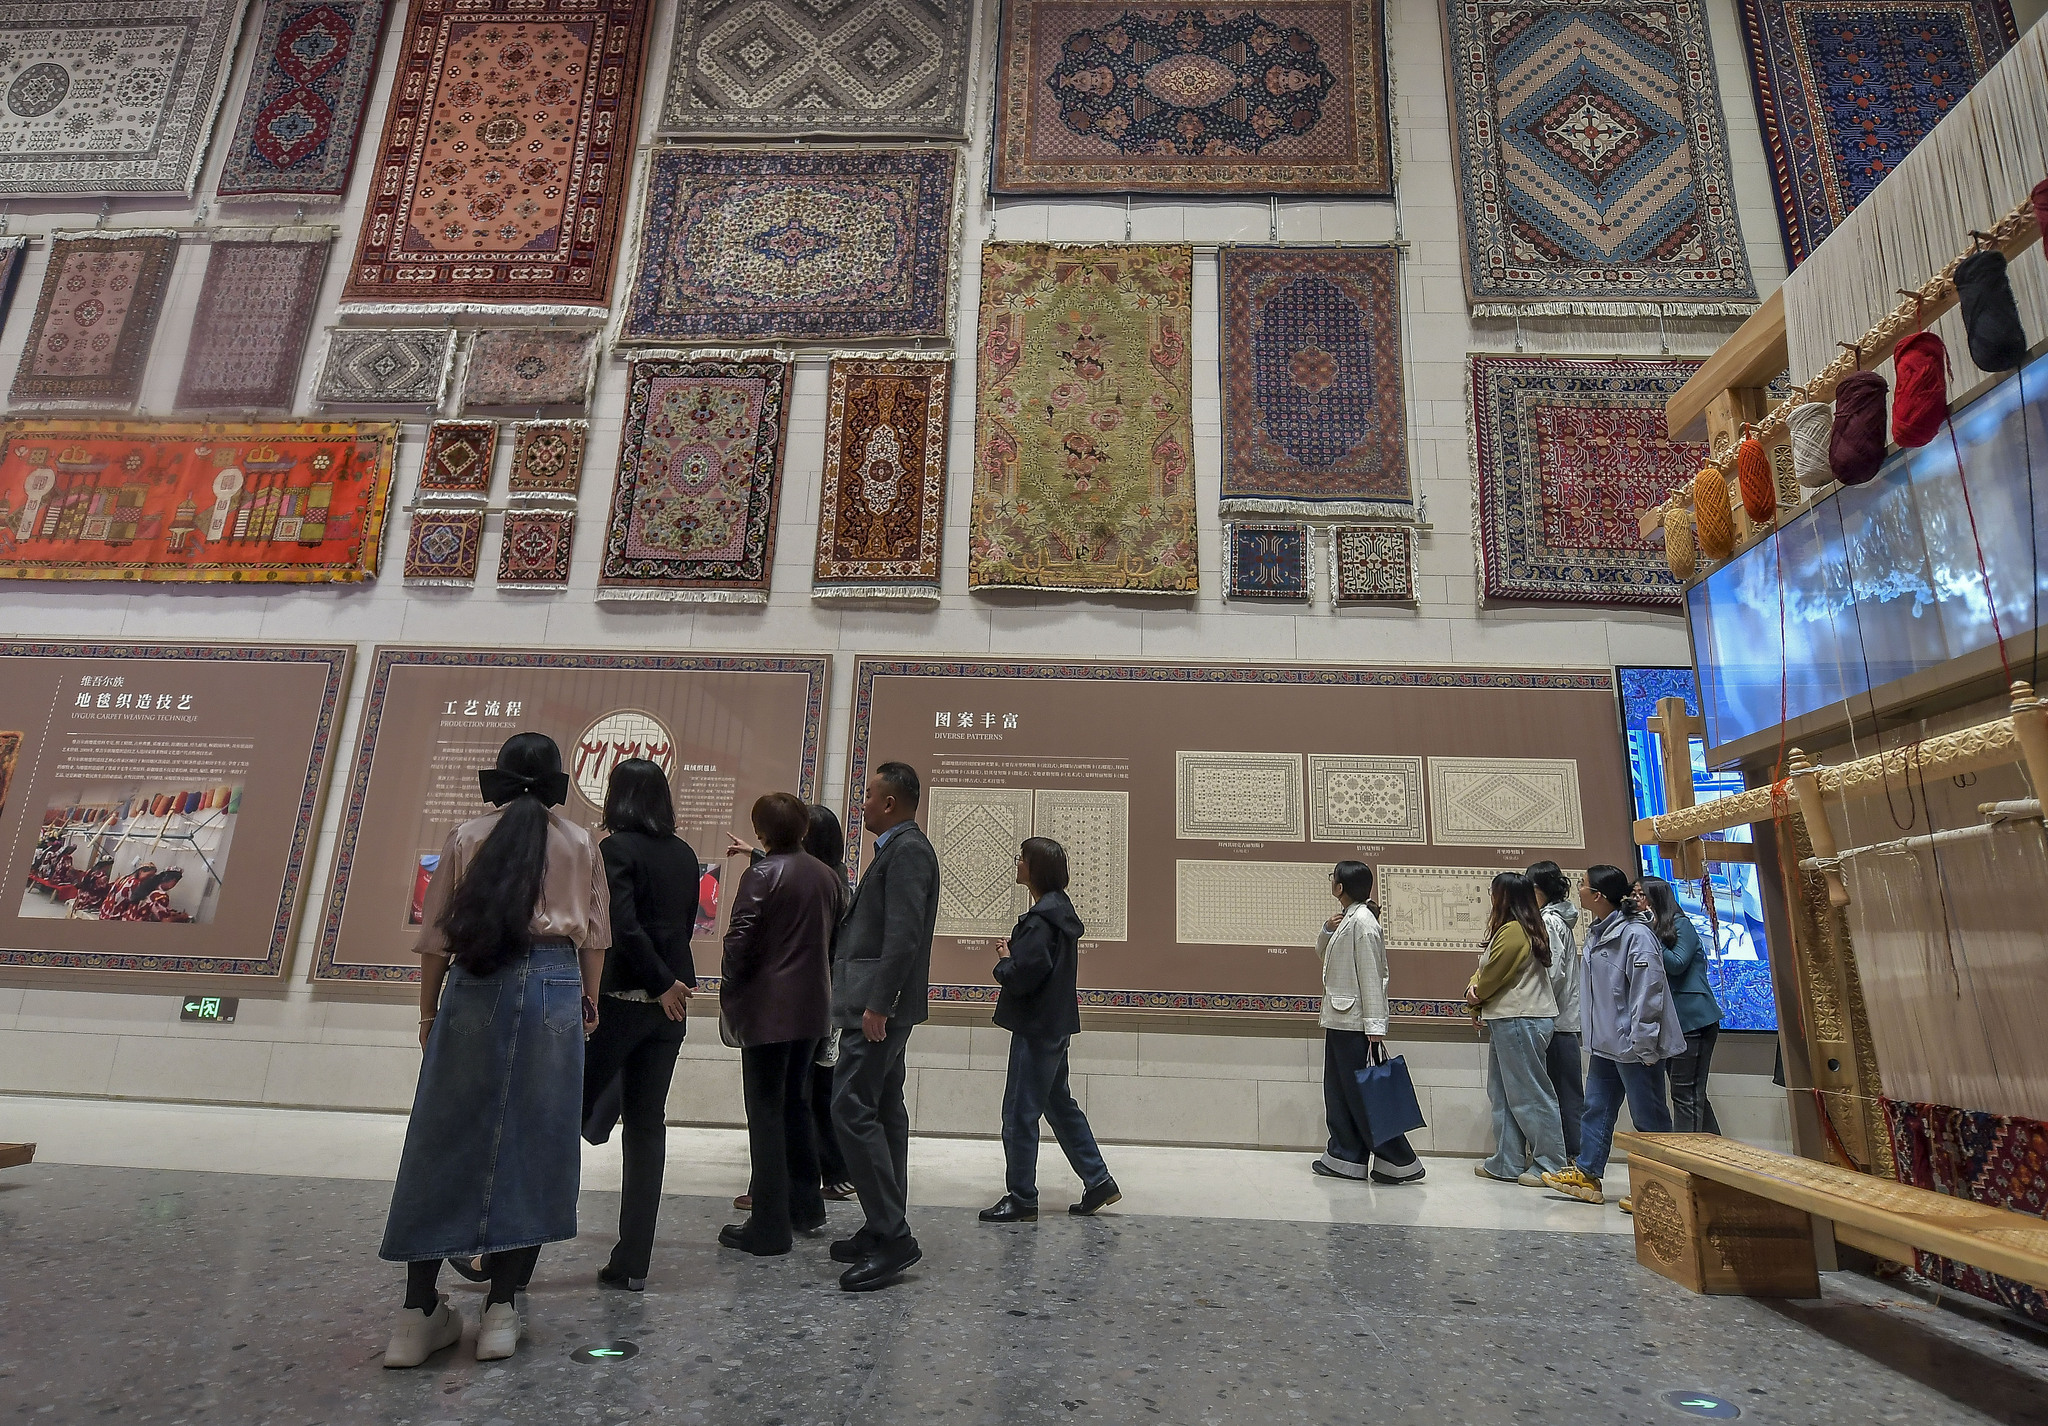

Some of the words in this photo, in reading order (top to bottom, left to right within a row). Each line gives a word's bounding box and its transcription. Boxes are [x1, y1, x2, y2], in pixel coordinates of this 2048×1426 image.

[80, 675, 125, 688] 维吾尔族
[74, 692, 193, 710] 地毯织造技艺
[440, 699, 522, 717] 工艺流程
[71, 712, 96, 720] UYGUR
[96, 712, 122, 721] CARPET
[123, 713, 155, 721] WEAVING
[157, 714, 198, 723] TECHNIQUE
[935, 711, 1019, 729] 图案丰富
[440, 720, 485, 729] PRODUCTION
[485, 721, 516, 729] PROCESS
[934, 732, 965, 740] DIVERSE
[966, 733, 1003, 741] PATTERNS
